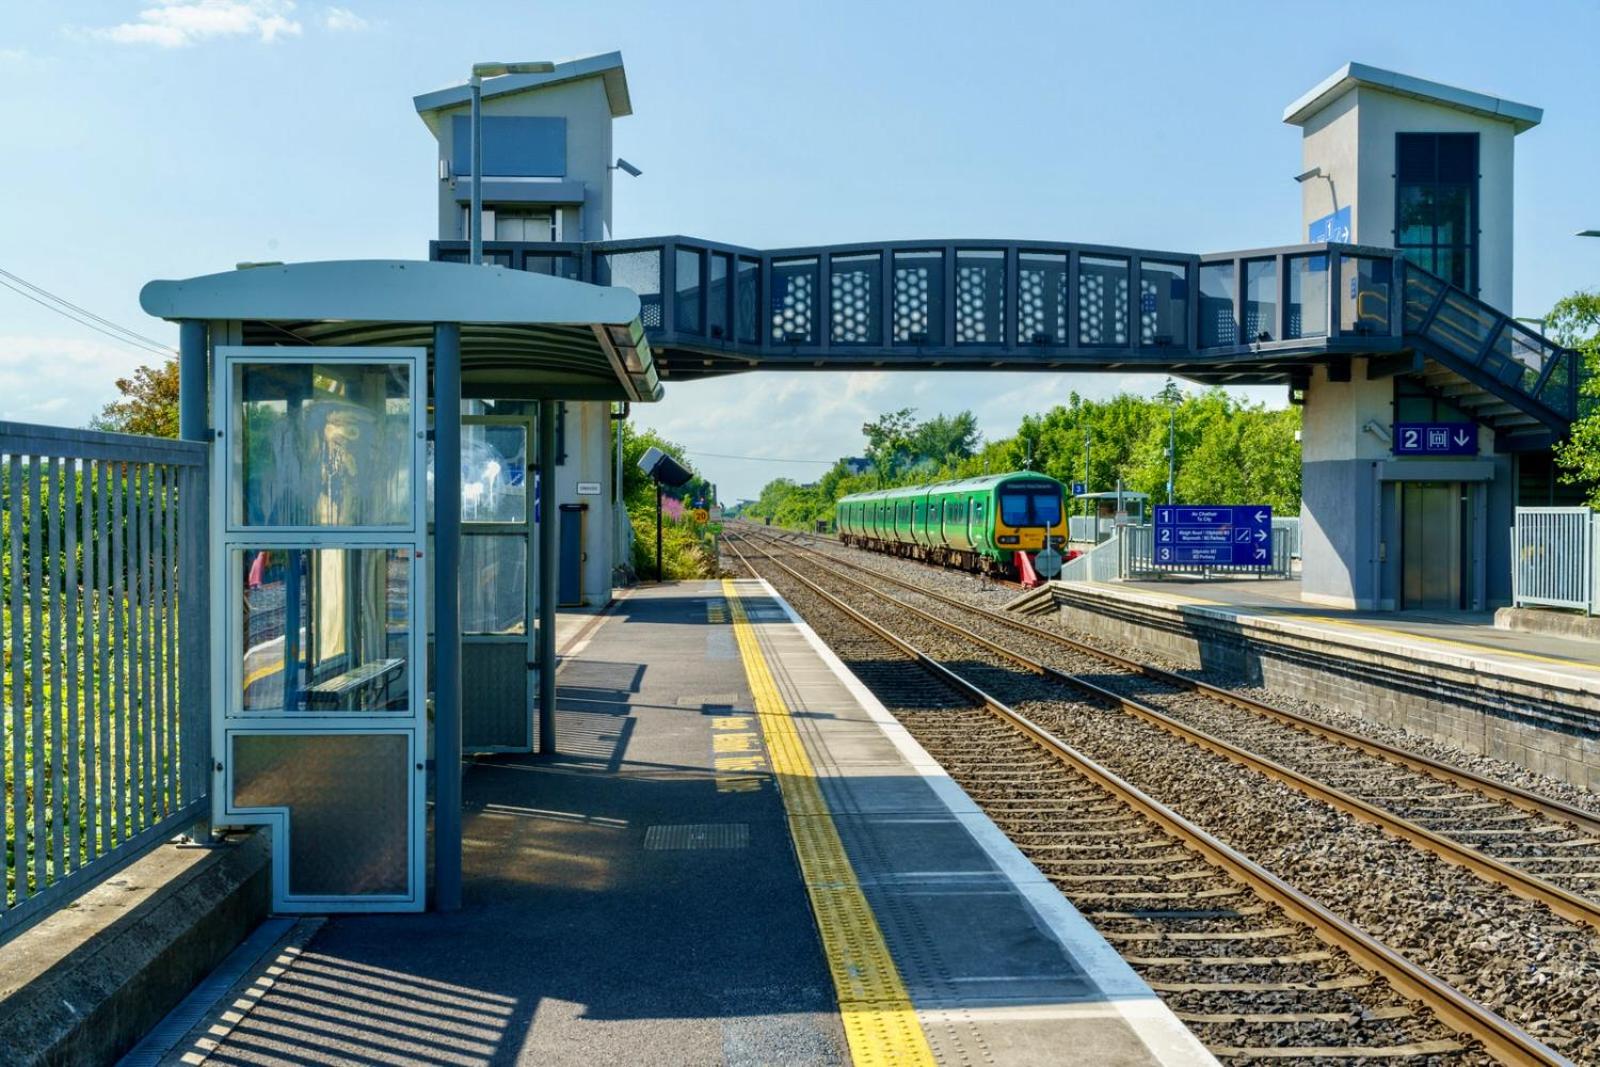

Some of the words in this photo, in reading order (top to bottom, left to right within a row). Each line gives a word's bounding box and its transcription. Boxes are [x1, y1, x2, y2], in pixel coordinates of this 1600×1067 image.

[1405, 430, 1418, 448] 2
[1075, 485, 1081, 493] 3
[695, 512, 706, 521] 20
[1162, 510, 1169, 523] 1
[1161, 529, 1170, 542] 2
[1161, 548, 1170, 560] 3
